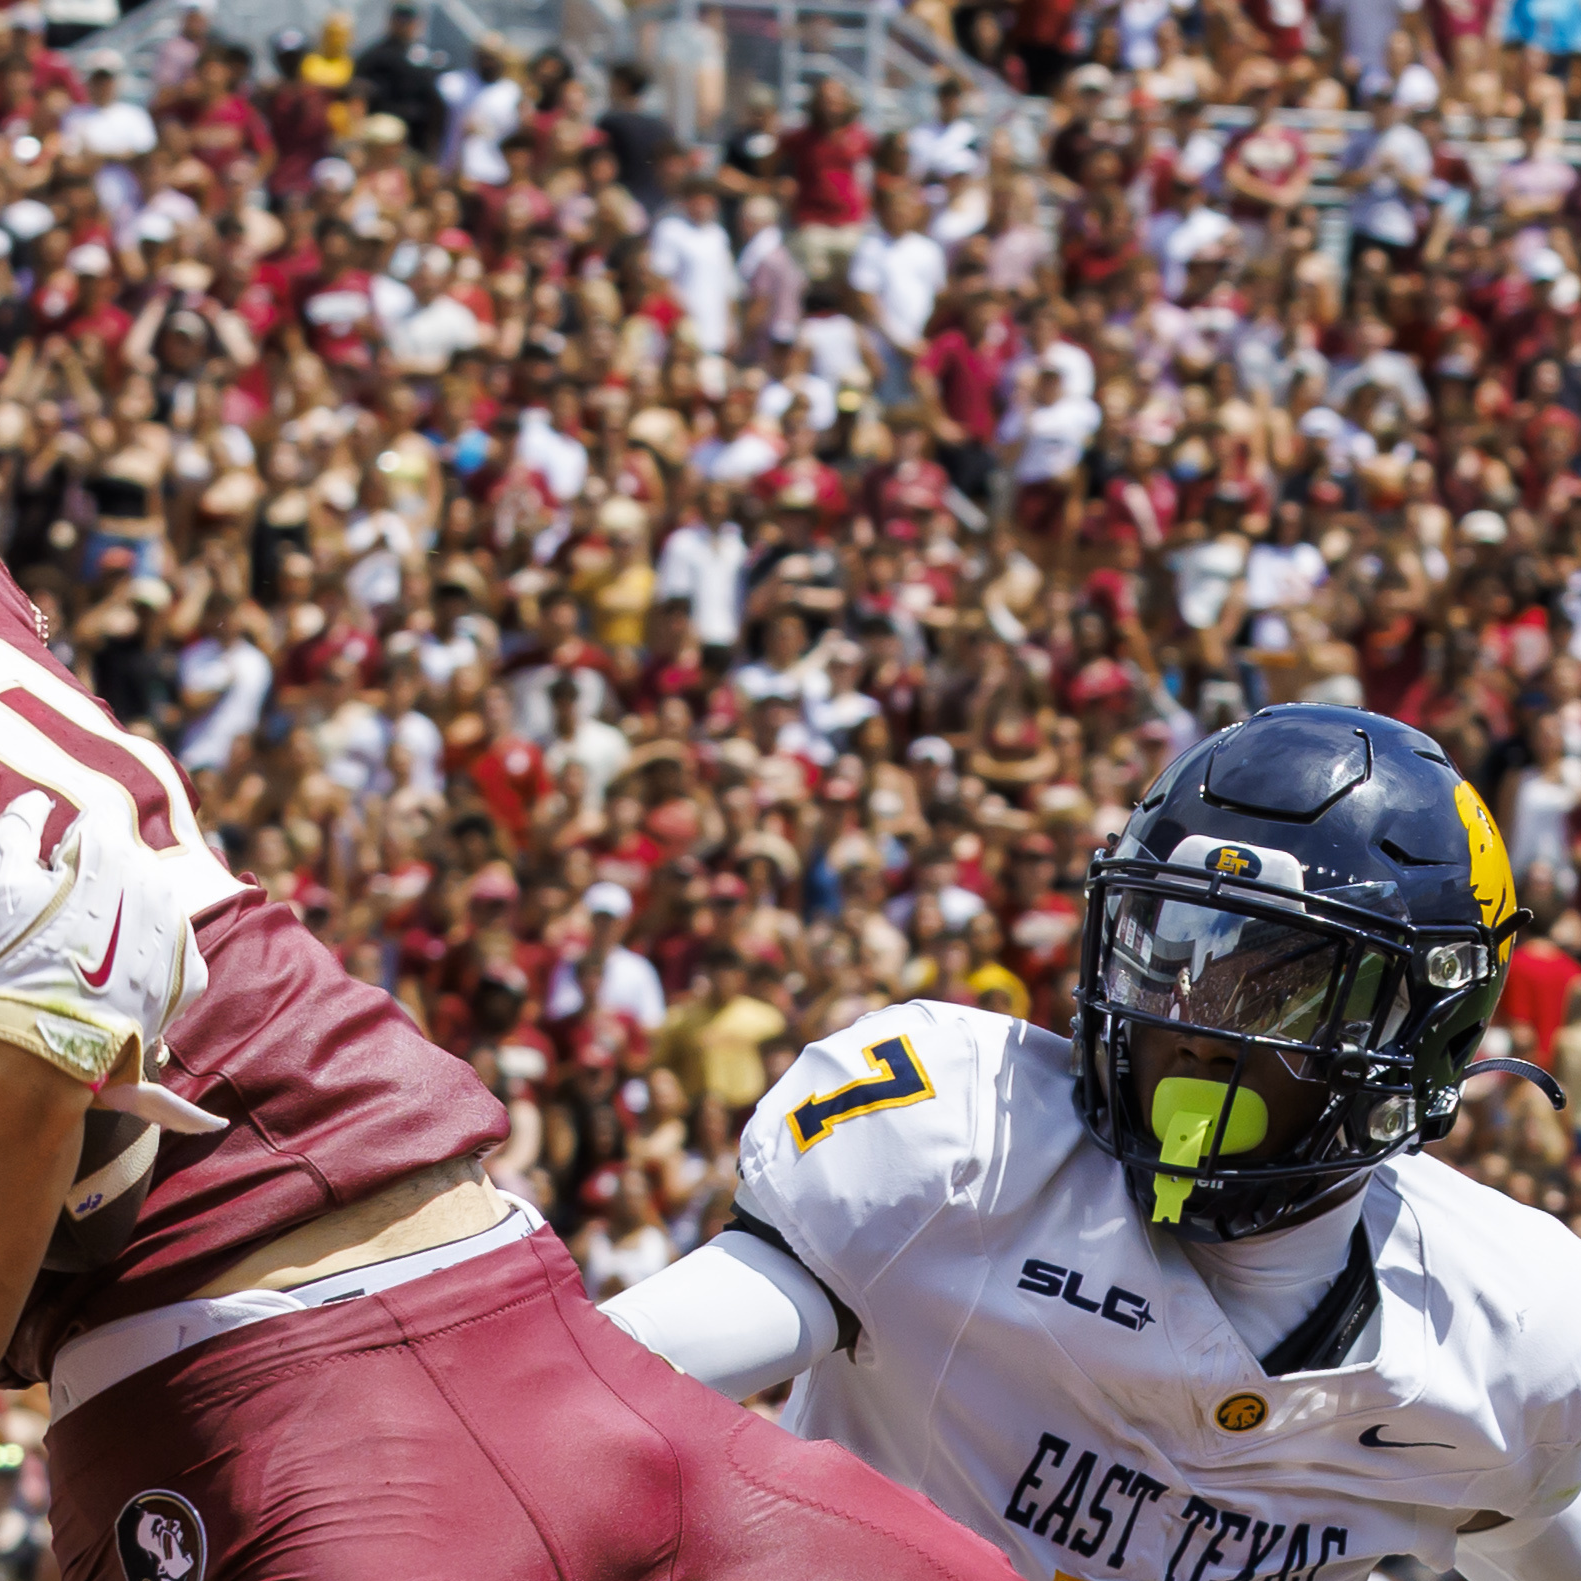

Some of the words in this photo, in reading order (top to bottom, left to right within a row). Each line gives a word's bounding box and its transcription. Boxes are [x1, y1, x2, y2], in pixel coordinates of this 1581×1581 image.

[785, 1033, 936, 1154] 7
[1017, 1258, 1151, 1331] SLC
[1003, 1431, 1170, 1570] EAST
